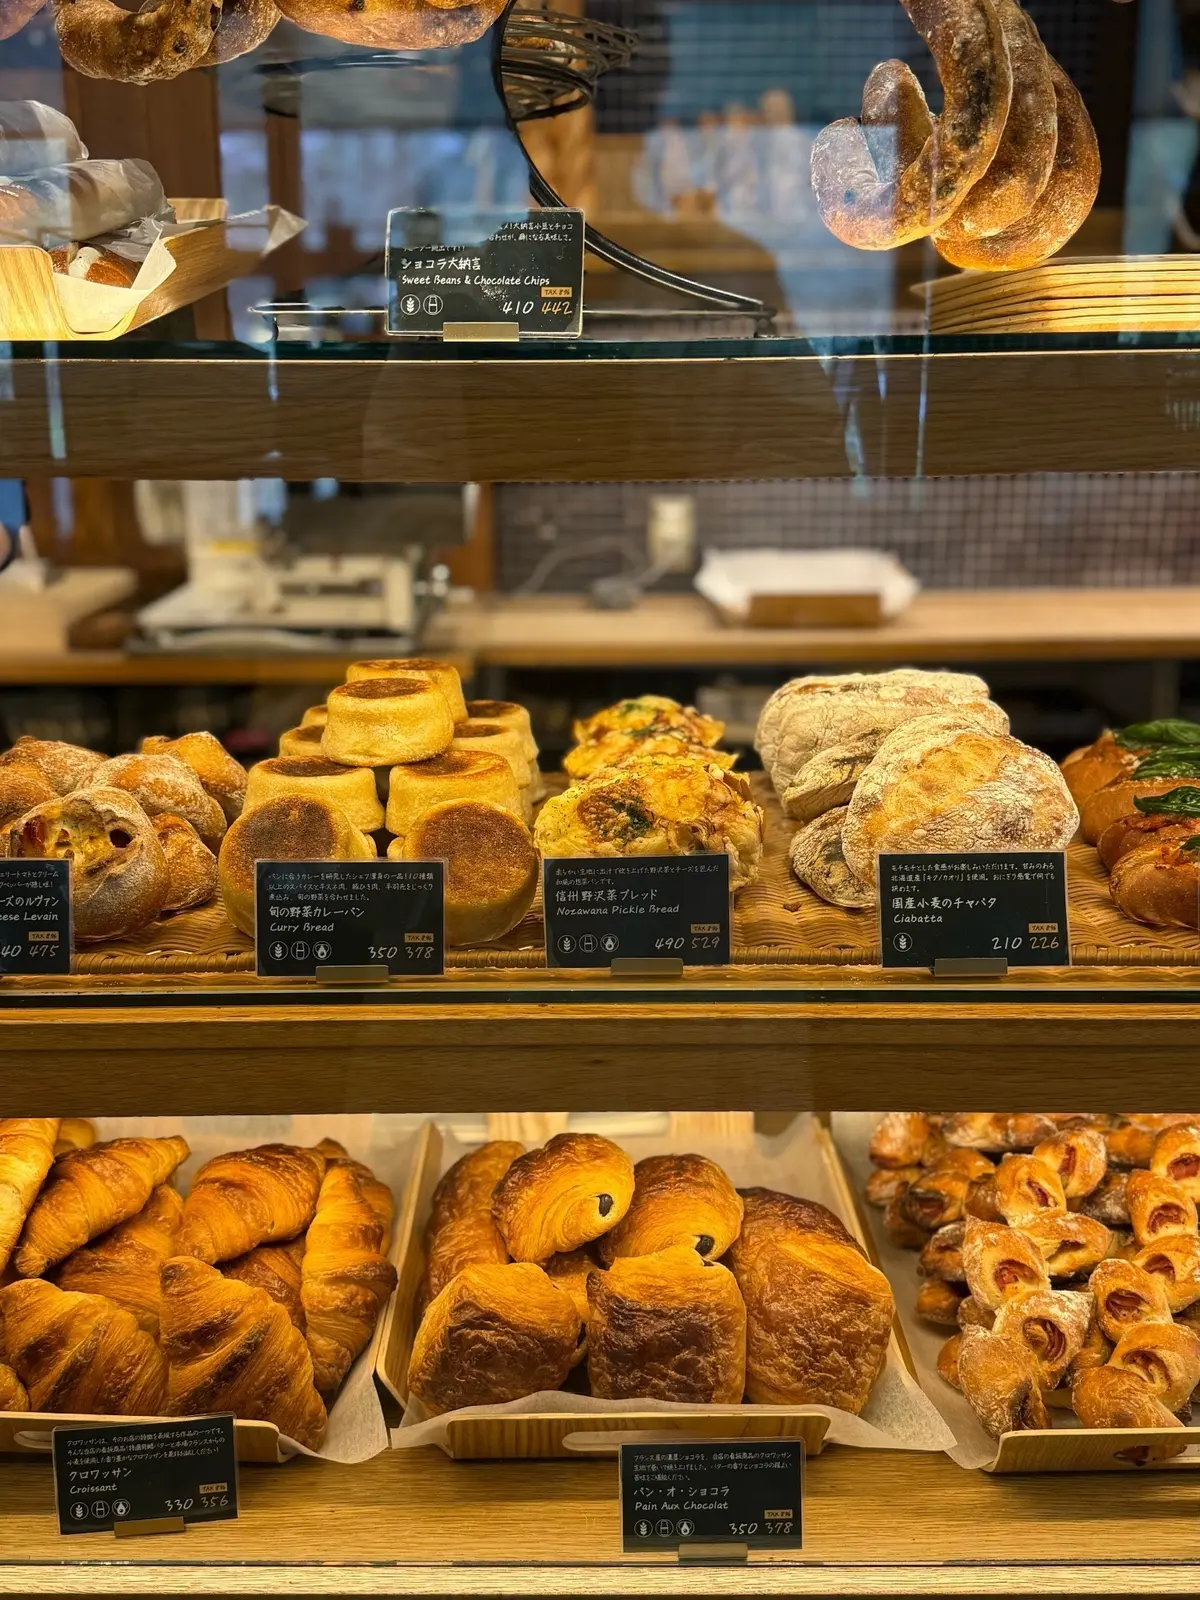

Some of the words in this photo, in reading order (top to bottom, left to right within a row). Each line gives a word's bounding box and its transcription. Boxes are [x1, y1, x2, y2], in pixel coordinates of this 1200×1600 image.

[402, 257, 480, 270] ショコラ大納言
[402, 275, 430, 284] Sweet
[434, 275, 461, 284] Beans
[465, 276, 471, 284] &
[474, 275, 521, 285] Chocolate
[524, 276, 549, 286] Chips
[503, 301, 534, 314] 410
[542, 302, 572, 314] 442
[0, 895, 59, 906] ーズのルヴァン
[555, 889, 657, 901] 信州野沢菜ブレッド
[893, 897, 996, 909] 国産小麦のチャバタ
[269, 906, 364, 917] 旬の野菜カレーパン
[557, 907, 608, 915] Nozawana
[612, 905, 645, 914] Pickle
[649, 904, 679, 913] Bread
[24, 912, 58, 920] Levain
[894, 914, 942, 923] Ciabatta
[270, 923, 299, 932] Curry
[303, 923, 334, 931] Bread
[655, 938, 684, 949] 490
[692, 936, 719, 948] 529
[992, 937, 1022, 949] 210
[1030, 937, 1059, 949] 226
[29, 945, 59, 957] 475
[368, 947, 397, 958] 350
[405, 947, 434, 958] 378
[69, 1468, 133, 1482] クロワッサン
[70, 1483, 117, 1494] Croissant
[634, 1486, 729, 1497] パン・オ・ショコラ
[165, 1499, 193, 1511] 330
[201, 1495, 228, 1507] 356
[635, 1502, 657, 1510] Pain
[661, 1502, 680, 1510] Aux
[684, 1501, 728, 1509] Chocolat
[729, 1523, 758, 1534] 350
[765, 1522, 793, 1533] 378
